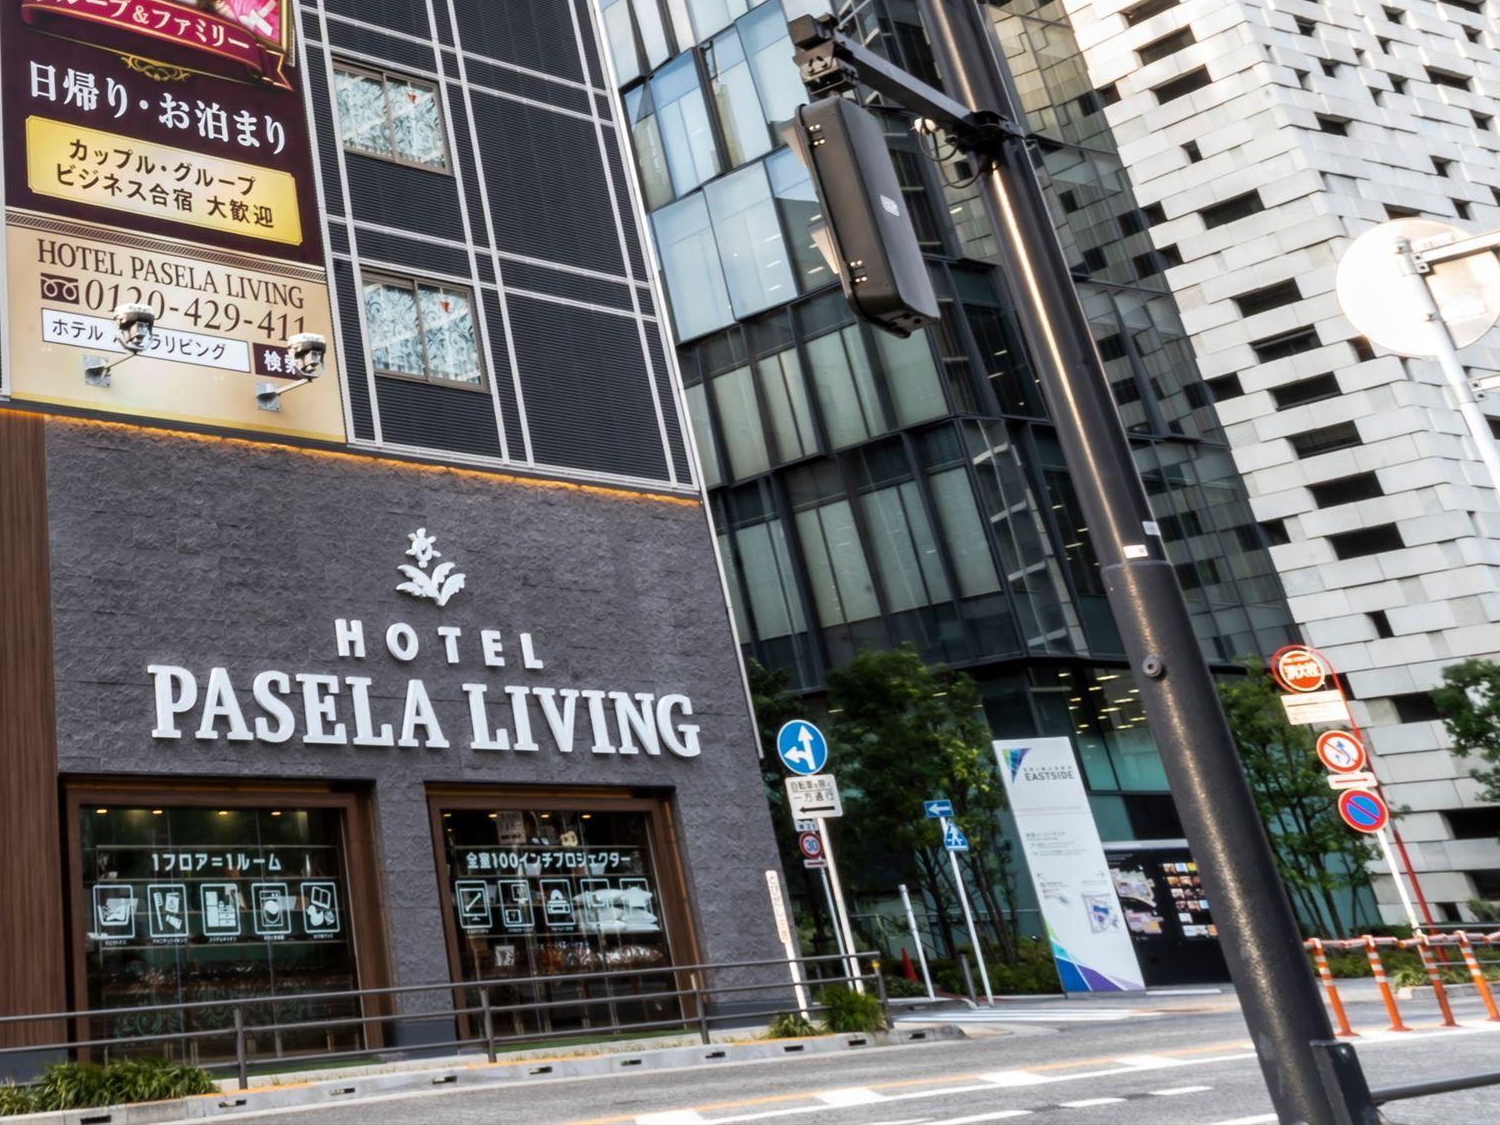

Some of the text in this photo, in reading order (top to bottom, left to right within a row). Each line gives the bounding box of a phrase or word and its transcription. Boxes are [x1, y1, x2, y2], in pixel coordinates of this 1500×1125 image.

[28, 59, 287, 156] 日帰り・お泊まり
[68, 137, 257, 197] カップル・グループ
[55, 162, 276, 230] ビジネス合宿 大歓迎
[37, 238, 305, 310] HOTEL PASELA LIVING
[51, 318, 104, 342] ホテル
[334, 617, 545, 671] HOTEL
[146, 663, 702, 759] PASELA LIVING
[793, 791, 835, 803] 一方通行
[1024, 771, 1075, 781] EASTSIDE
[804, 837, 819, 852] 30
